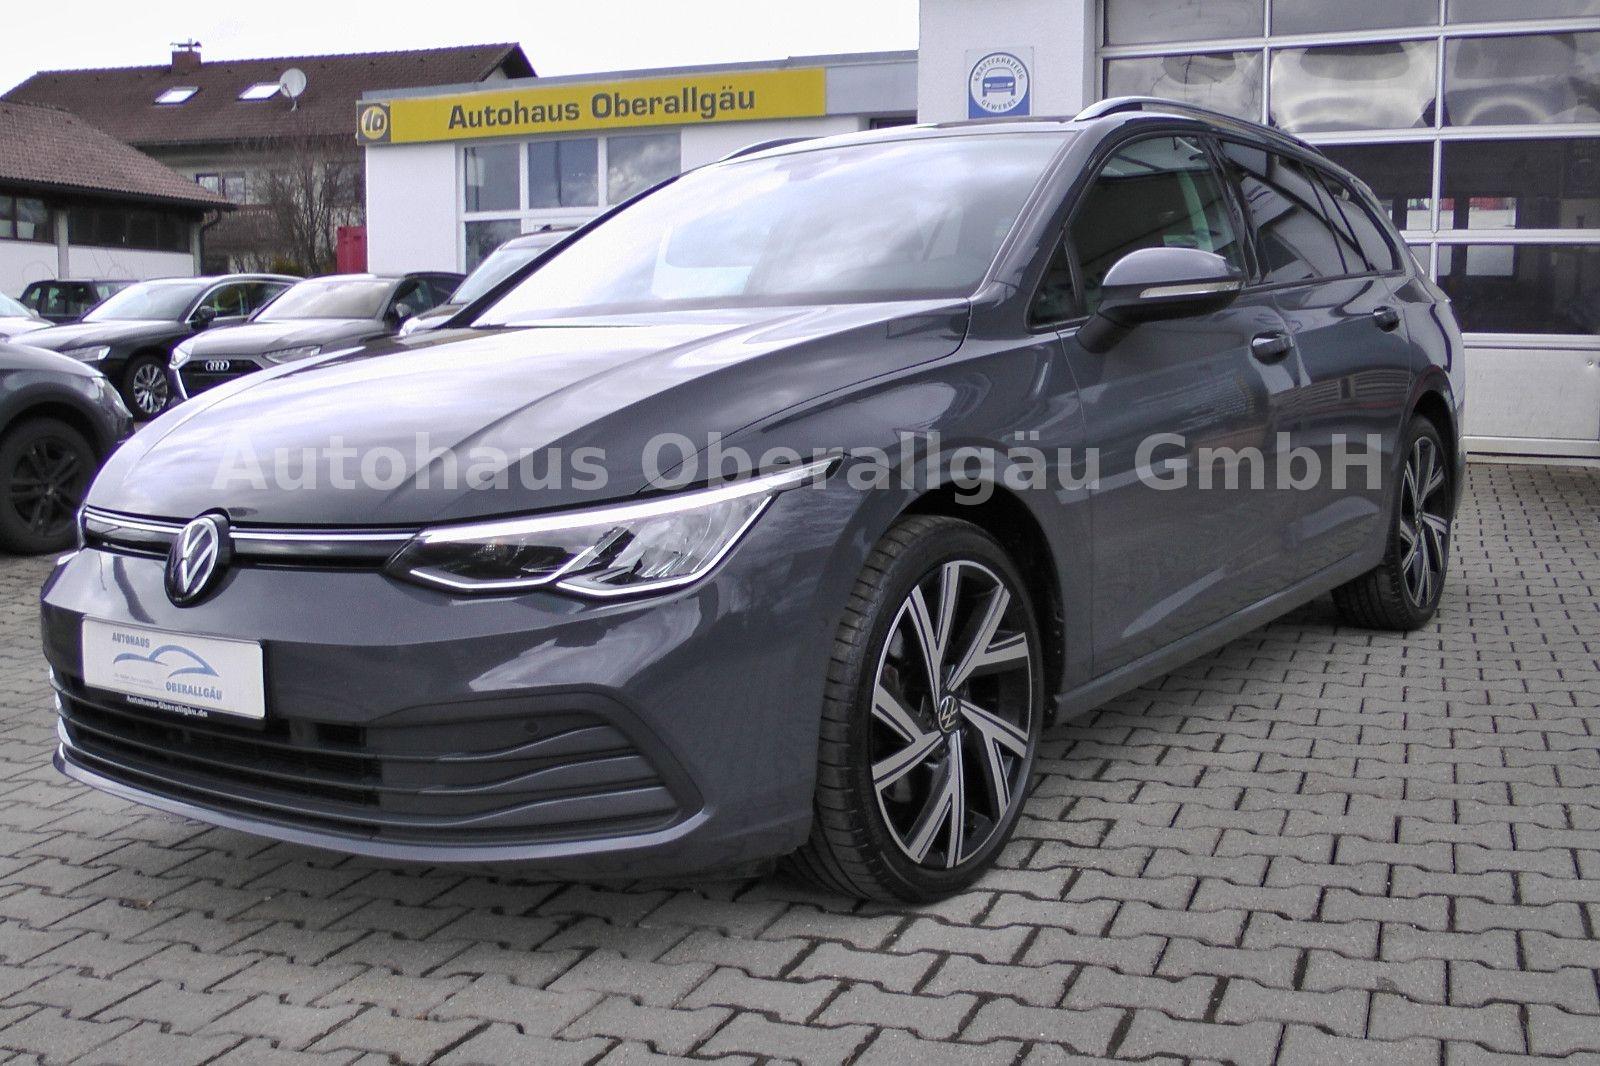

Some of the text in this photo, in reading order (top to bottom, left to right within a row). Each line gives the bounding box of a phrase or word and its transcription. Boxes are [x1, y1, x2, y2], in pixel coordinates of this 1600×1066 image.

[448, 84, 755, 130] Autohaus Oberallgäu
[112, 631, 151, 649] AUTOHAUS
[166, 681, 224, 701] OBERALLGÄU
